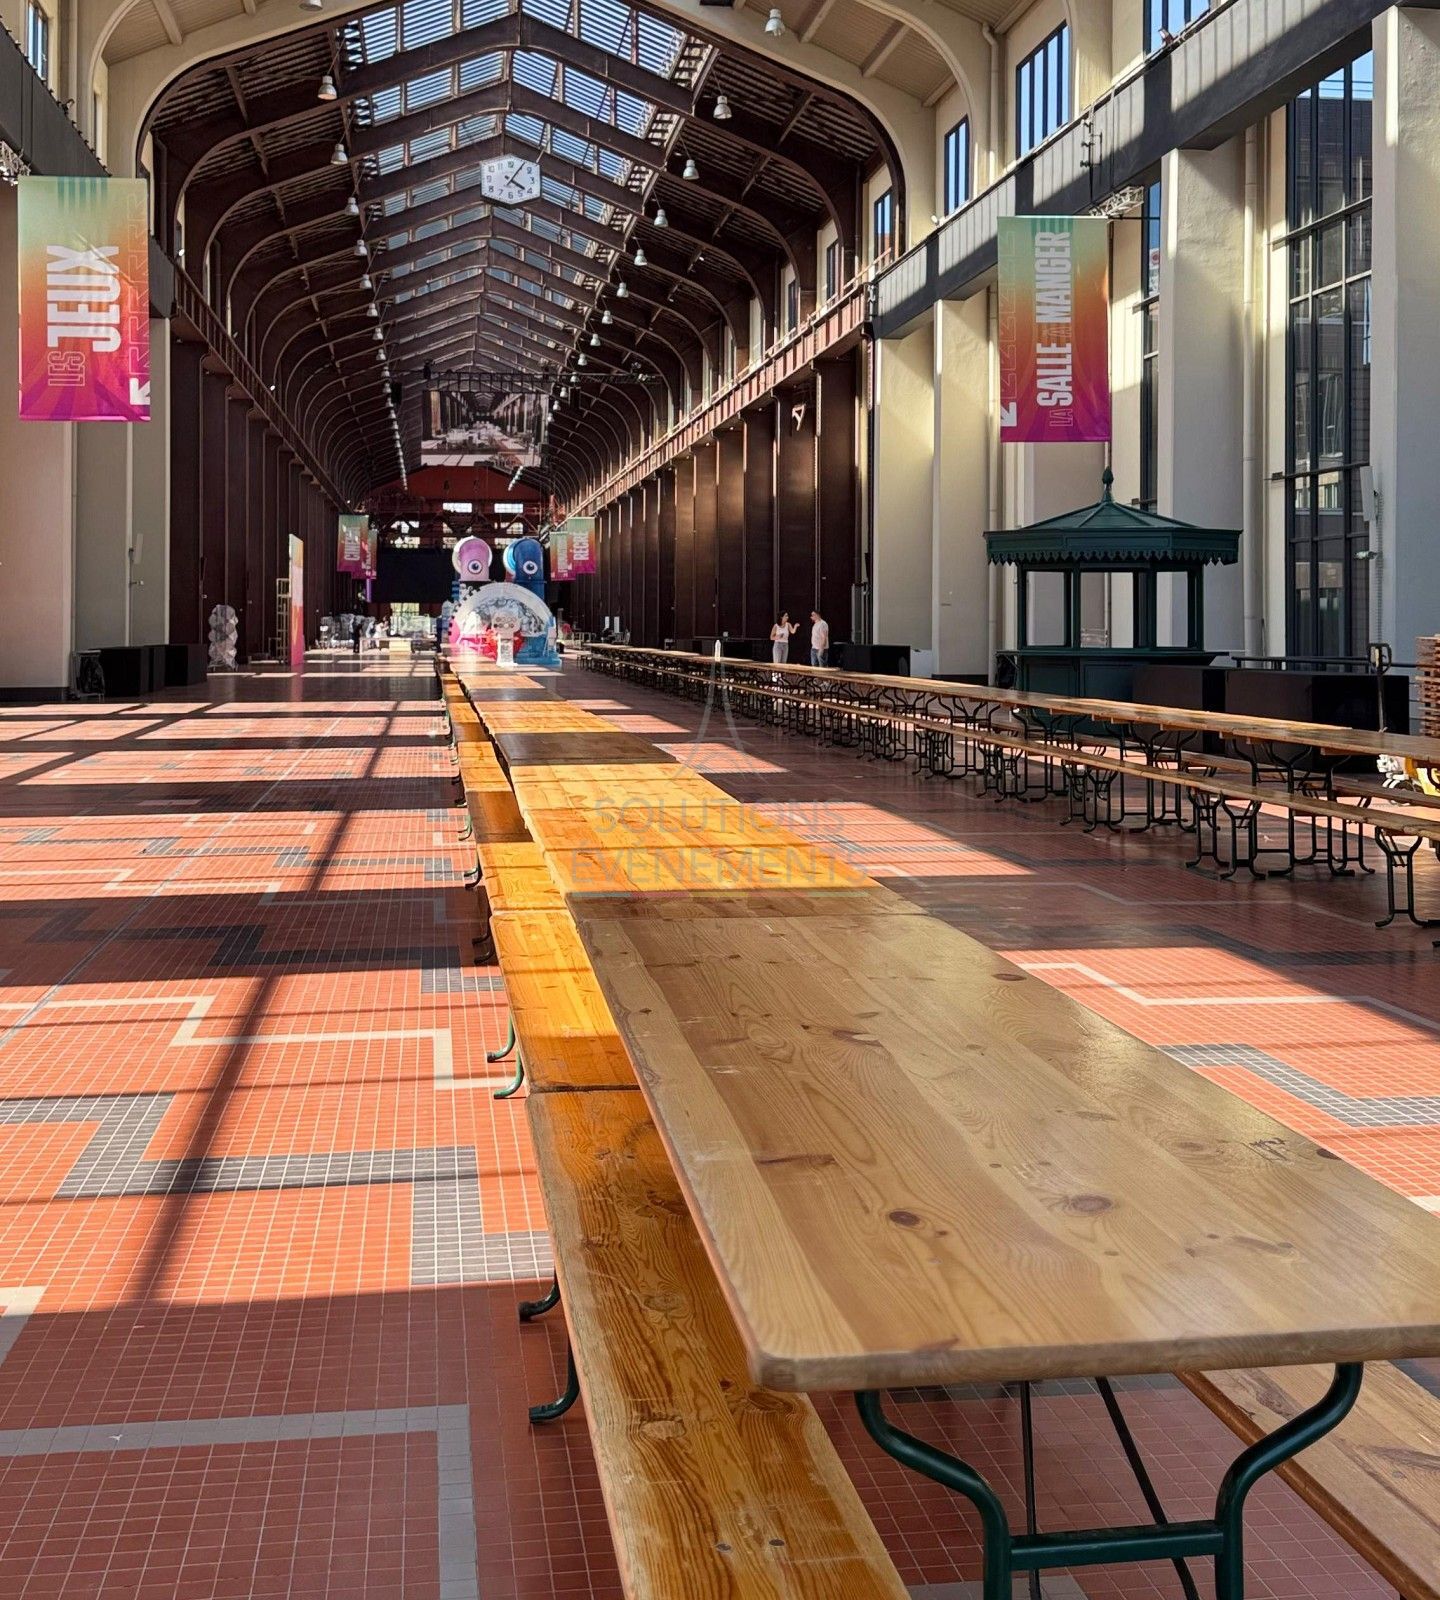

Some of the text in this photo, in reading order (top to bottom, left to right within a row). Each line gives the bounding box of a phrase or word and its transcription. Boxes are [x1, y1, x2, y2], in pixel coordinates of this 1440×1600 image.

[1034, 232, 1071, 323] MANGER
[47, 246, 121, 387] LES JEUX
[1036, 343, 1073, 407] SALLE
[1049, 409, 1073, 427] LA
[569, 531, 590, 561] RÉCRÉ
